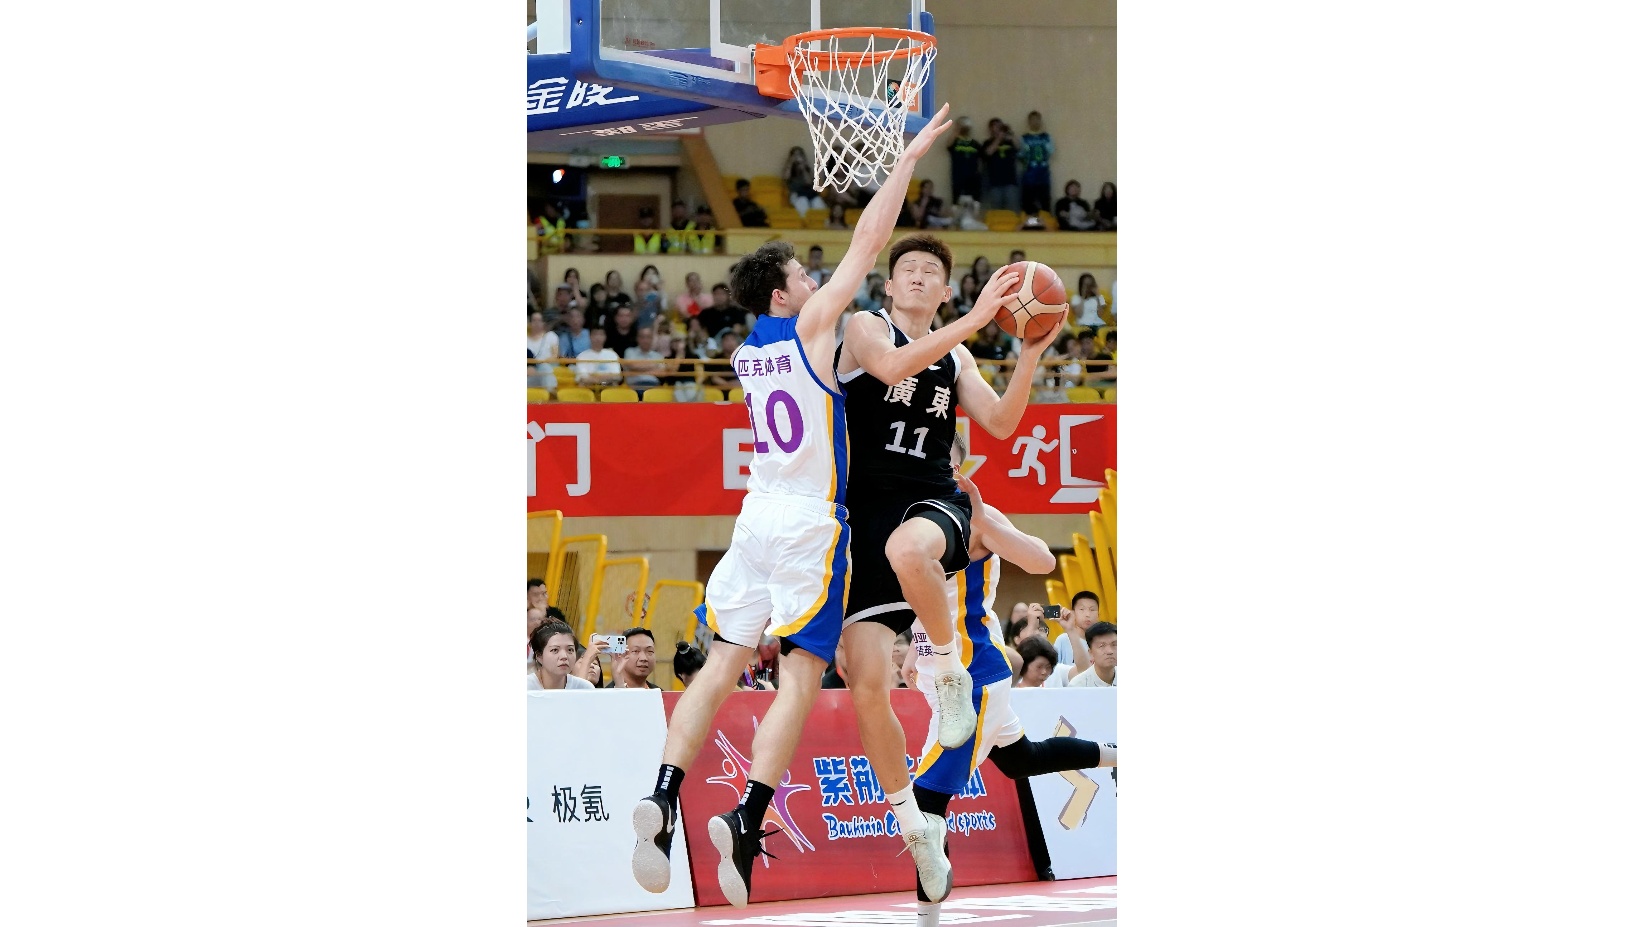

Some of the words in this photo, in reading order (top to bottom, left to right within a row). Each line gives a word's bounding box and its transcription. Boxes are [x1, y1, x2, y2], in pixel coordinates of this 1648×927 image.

[738, 354, 792, 377] 匹克体育
[883, 376, 951, 420] 廣東
[745, 390, 804, 454] 10
[885, 421, 930, 460] 11
[551, 784, 610, 823] 极氪
[822, 813, 884, 840] Bauhinia
[957, 810, 996, 836] sports
